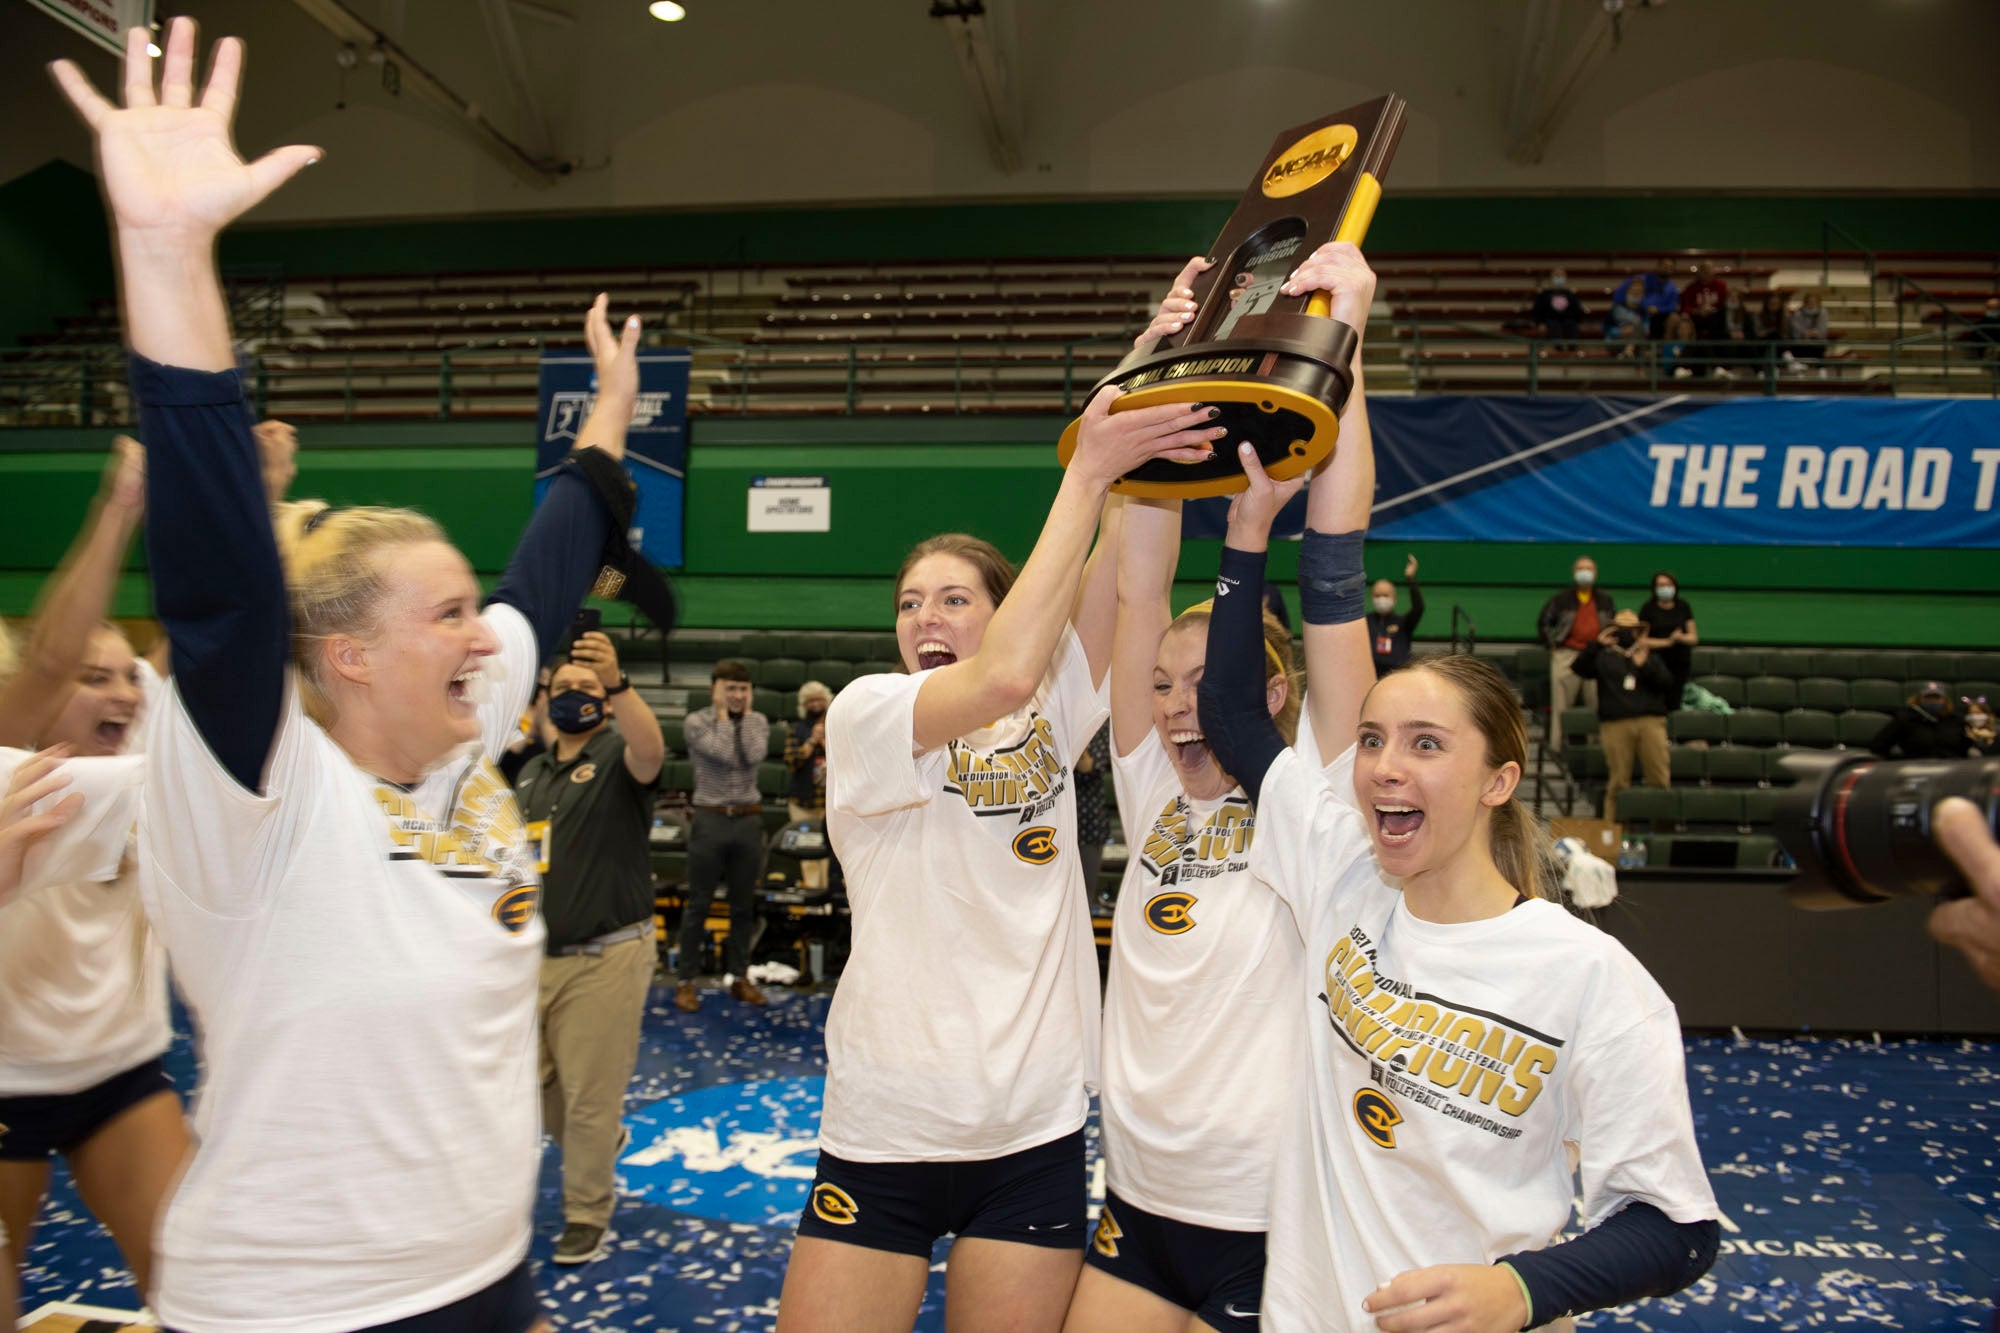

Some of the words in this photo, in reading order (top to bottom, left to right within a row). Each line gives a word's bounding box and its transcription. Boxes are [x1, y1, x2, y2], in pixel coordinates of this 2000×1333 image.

[1265, 143, 1348, 182] NCAA
[1245, 242, 1303, 268] DIVISION
[1125, 367, 1163, 390] IONAL
[1164, 358, 1254, 380] CHAMPION
[1648, 444, 1766, 507] THE
[1777, 446, 1953, 511] ROAD
[1971, 448, 2000, 511] T
[969, 771, 1009, 783] DIVISION
[1326, 936, 1557, 1117] CHAMPIONS
[1392, 1026, 1437, 1045] WOMEN'S
[1440, 1039, 1509, 1075] VOLLEYBALL
[1385, 1075, 1439, 1111] VOLLEYBALL
[1442, 1103, 1523, 1140] CHAMPIONSHIP
